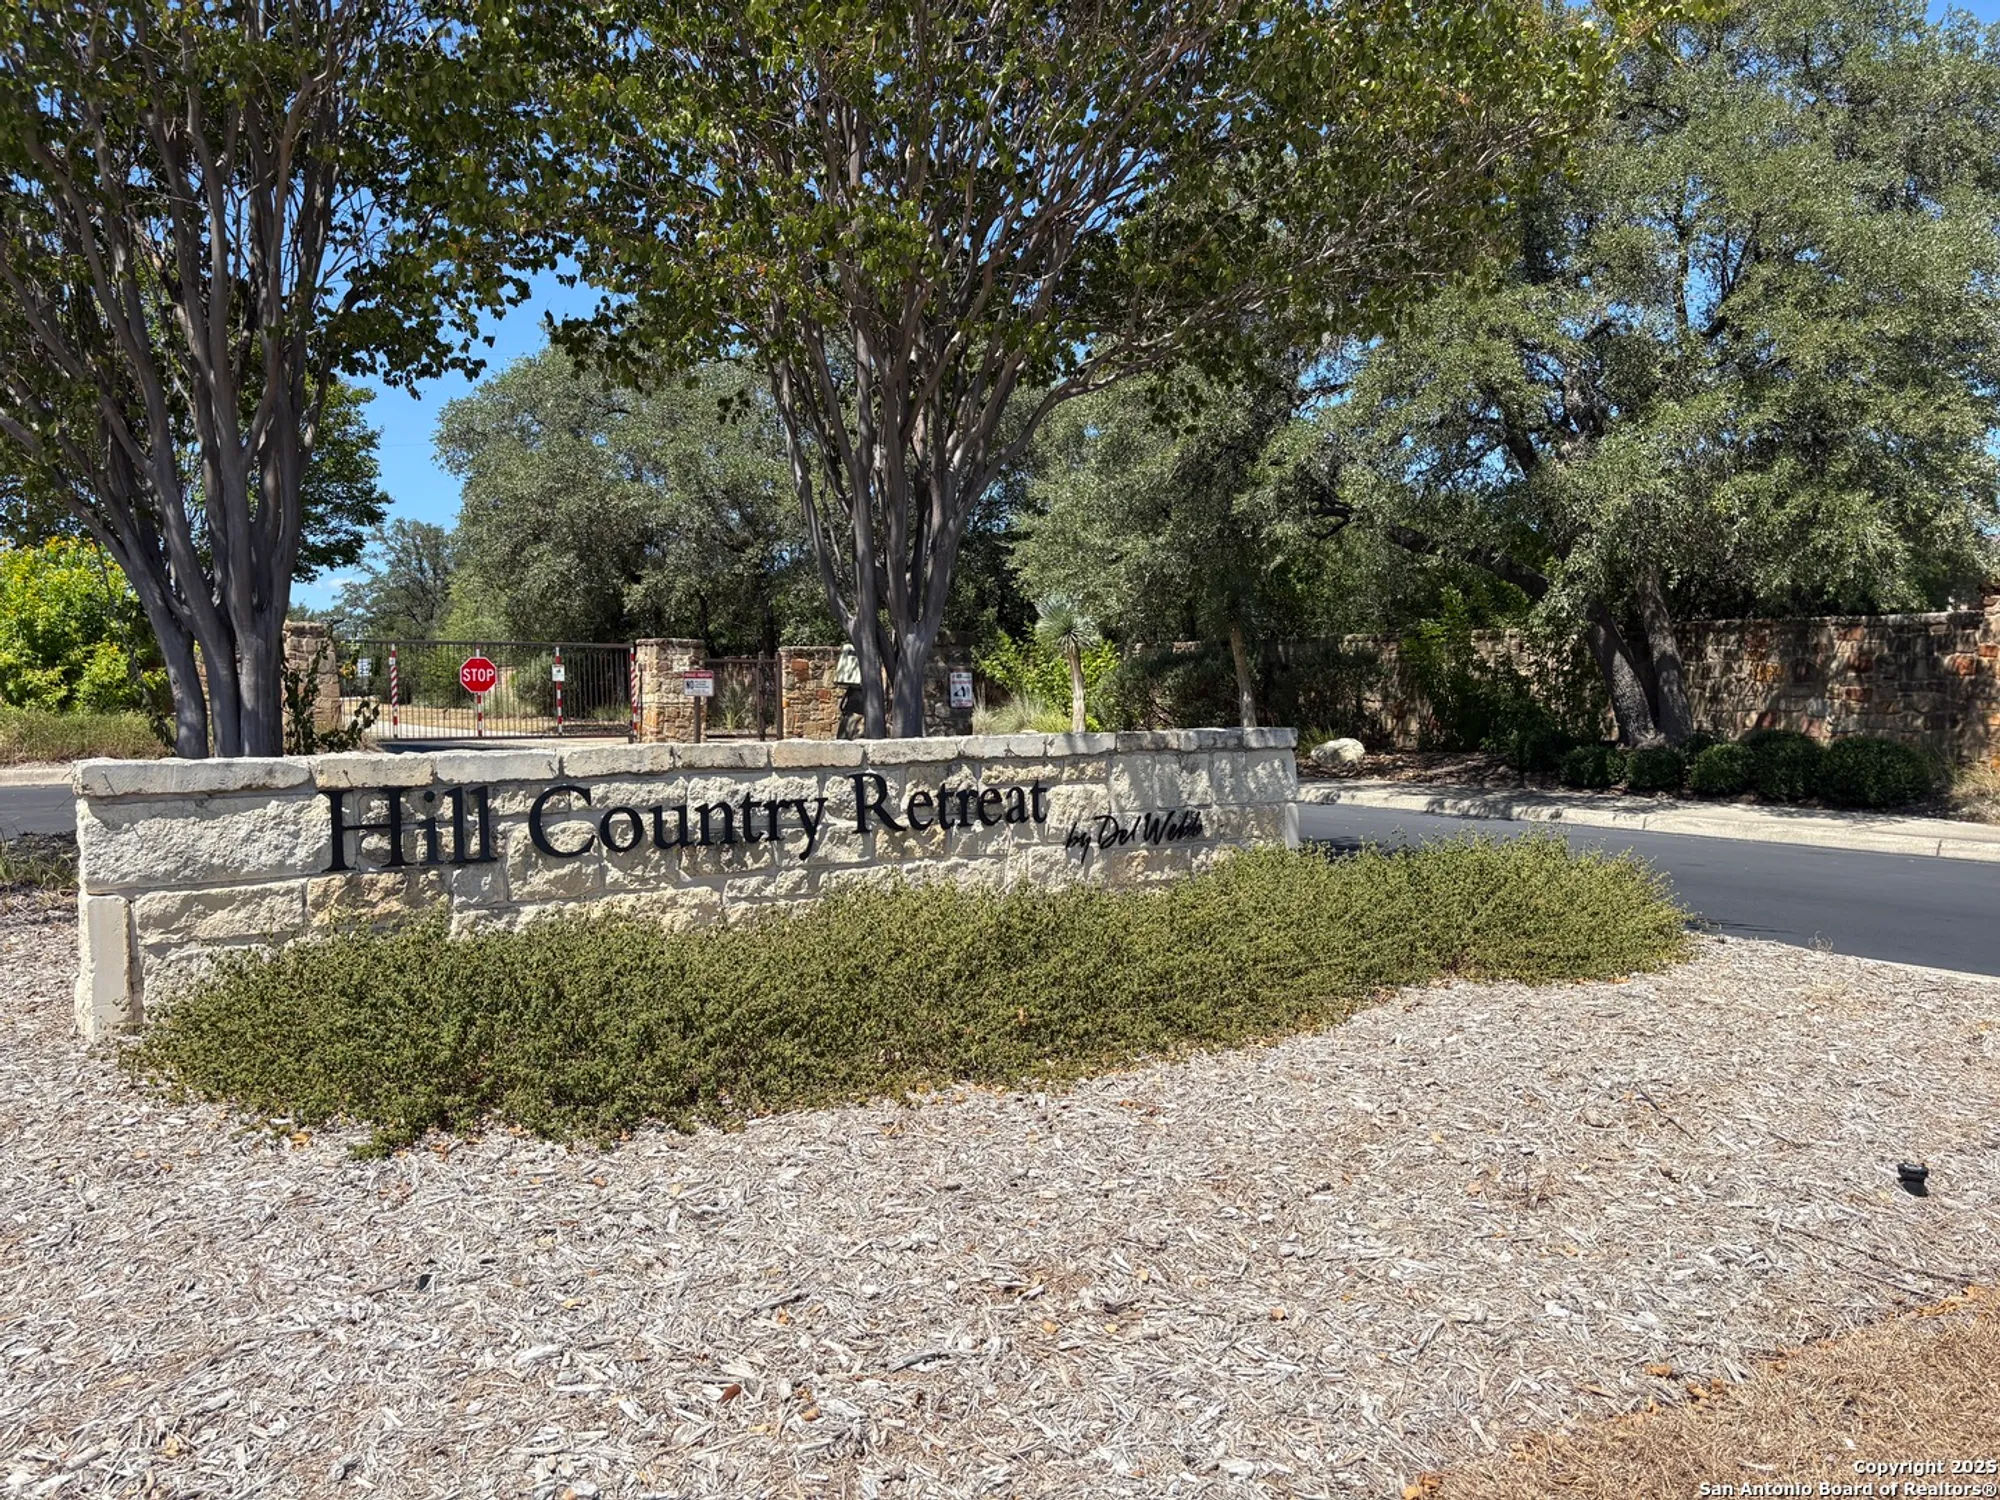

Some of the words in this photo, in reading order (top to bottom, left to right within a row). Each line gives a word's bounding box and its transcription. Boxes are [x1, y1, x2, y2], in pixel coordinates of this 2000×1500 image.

[463, 668, 494, 682] STOP
[323, 785, 497, 873] Hill
[529, 785, 828, 861] Country
[849, 772, 1048, 833] Retreat
[1066, 821, 1091, 863] by
[1094, 815, 1142, 849] Del
[1143, 810, 1203, 845] Webb
